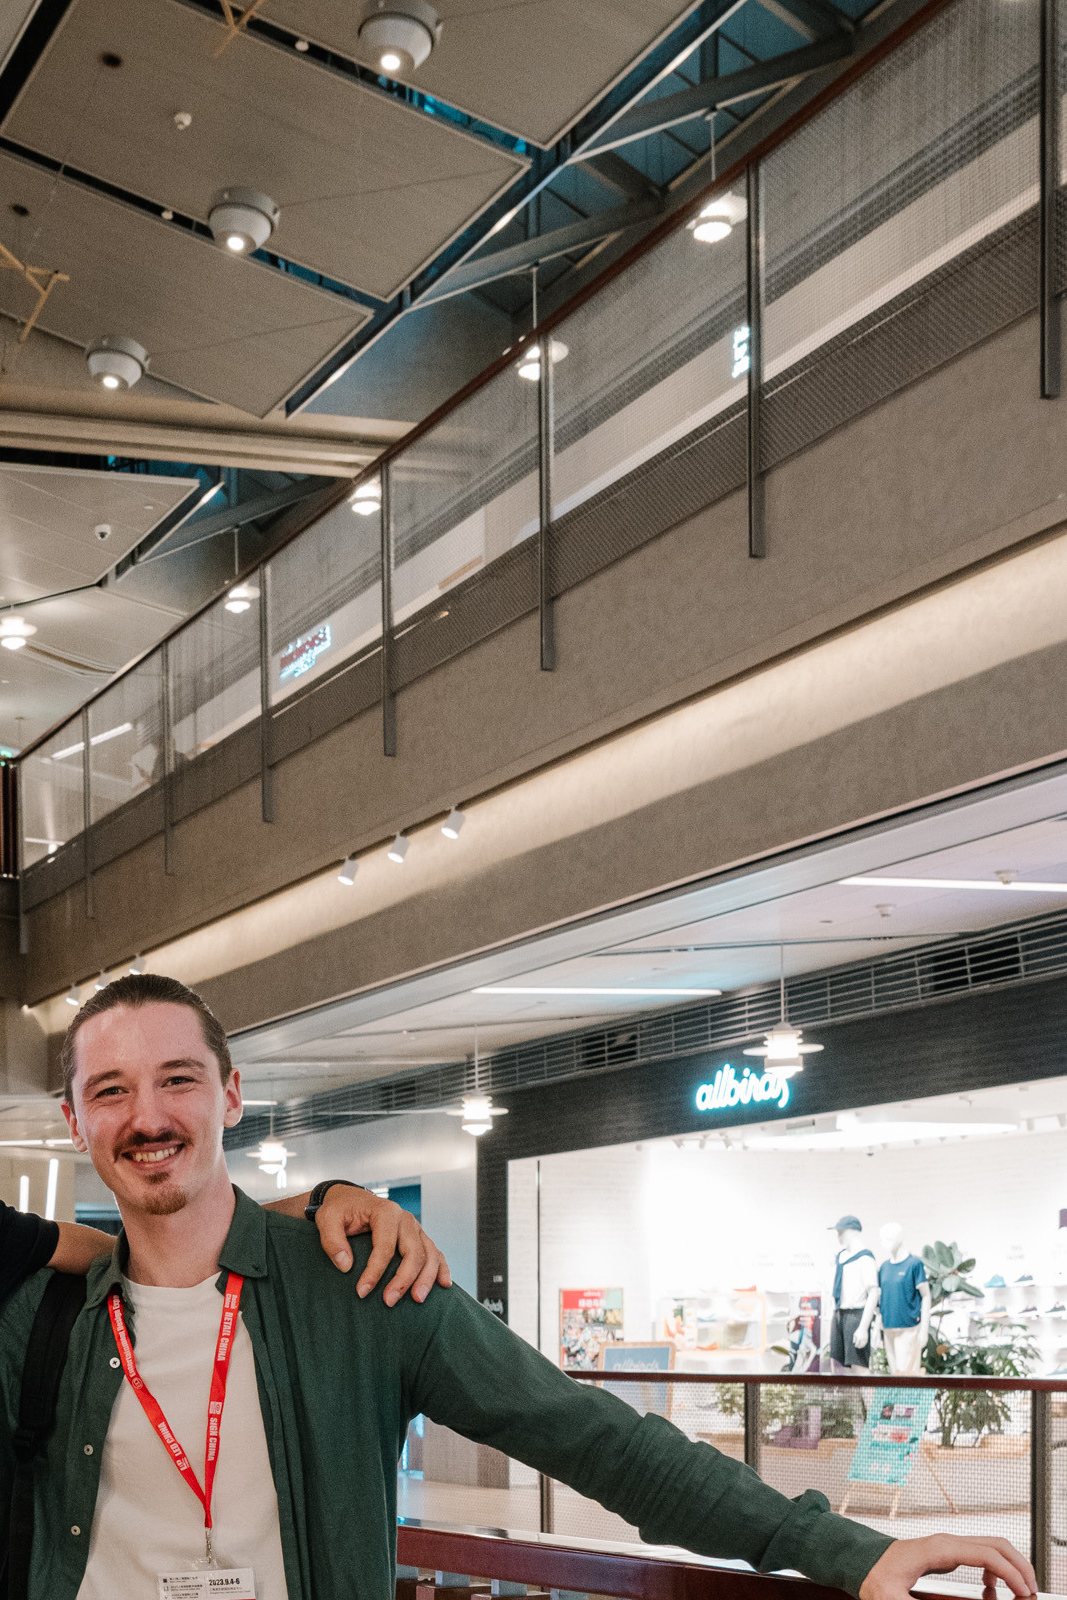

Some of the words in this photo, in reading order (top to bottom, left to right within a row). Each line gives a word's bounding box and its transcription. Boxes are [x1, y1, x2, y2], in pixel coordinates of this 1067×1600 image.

[221, 1311, 234, 1336] RETAIL
[217, 1337, 230, 1361] CHINA
[157, 1421, 175, 1444] CHINA
[209, 1417, 218, 1436] SIGN
[170, 1442, 183, 1457] LED
[207, 1437, 218, 1462] CHINA
